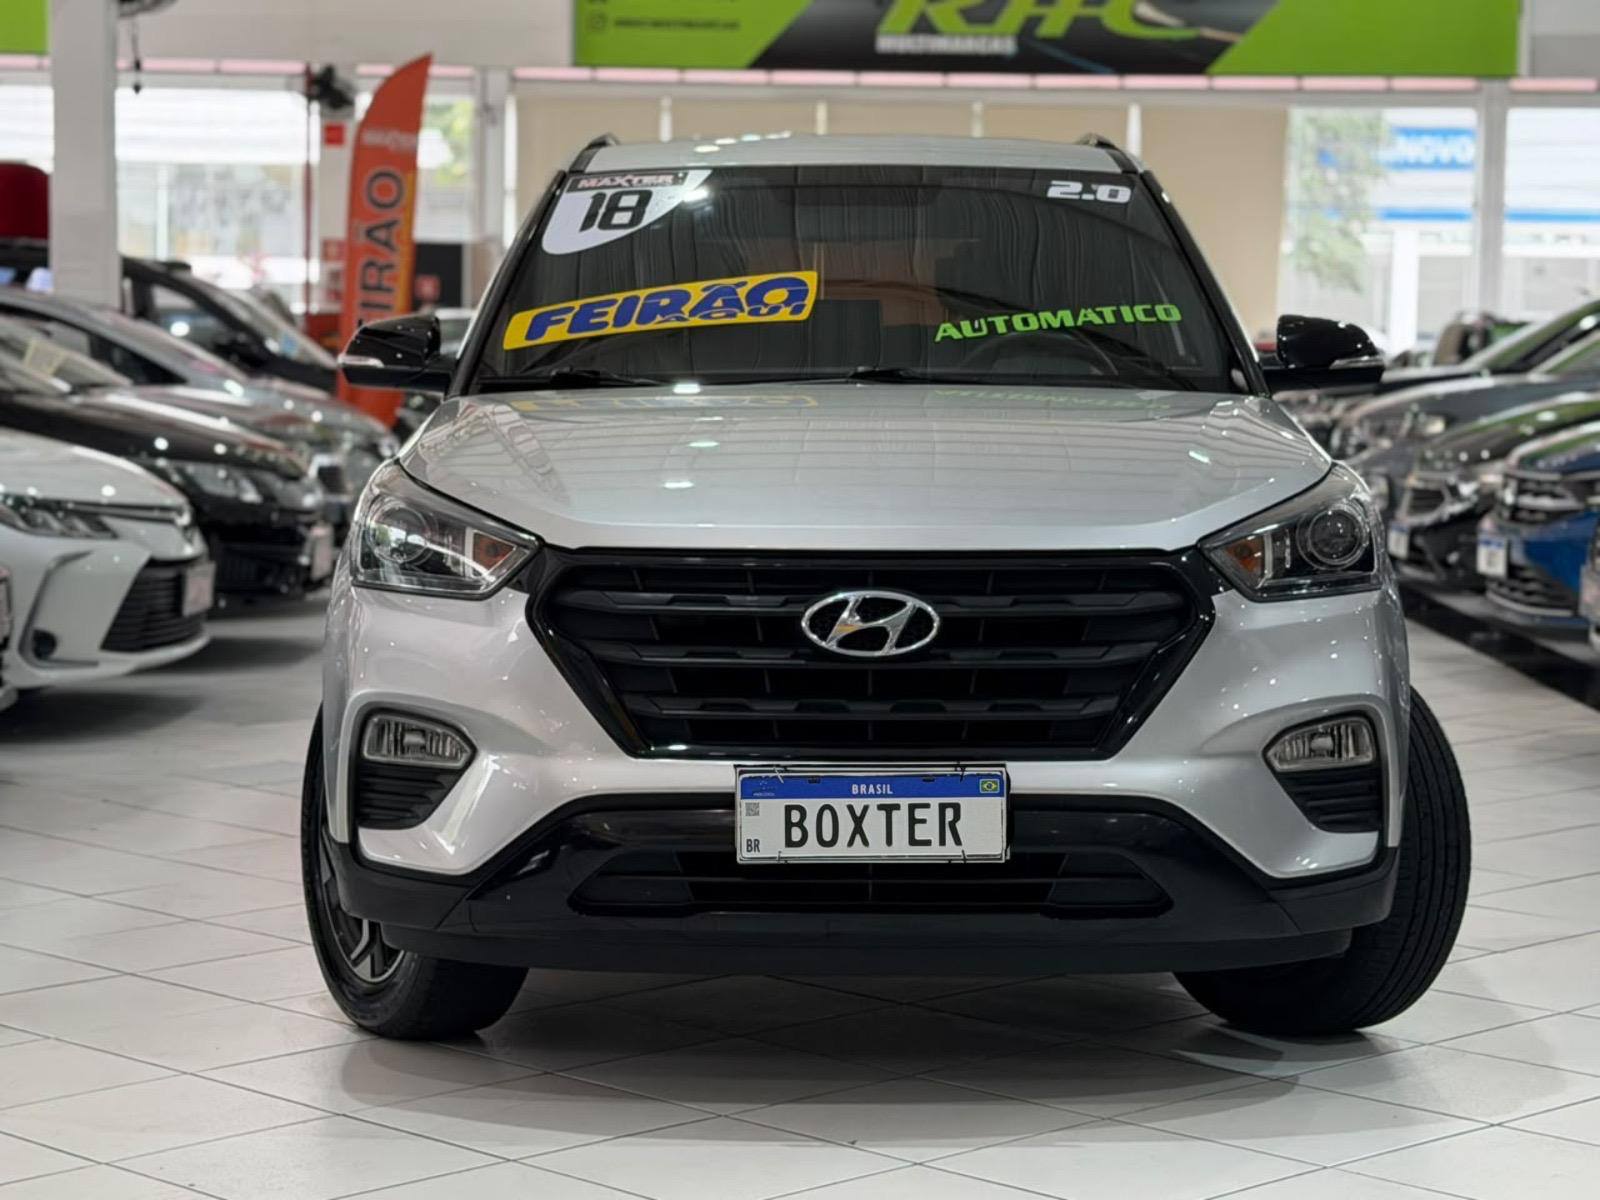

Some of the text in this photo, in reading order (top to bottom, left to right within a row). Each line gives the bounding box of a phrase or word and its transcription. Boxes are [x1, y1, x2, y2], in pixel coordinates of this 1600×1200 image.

[580, 190, 653, 232] 18
[1047, 180, 1131, 204] 2.0
[357, 168, 404, 326] IRÃO
[525, 277, 809, 341] FEIRÃO
[852, 783, 893, 795] BRASIL
[746, 838, 760, 853] BR
[784, 802, 963, 848] BOXTER
